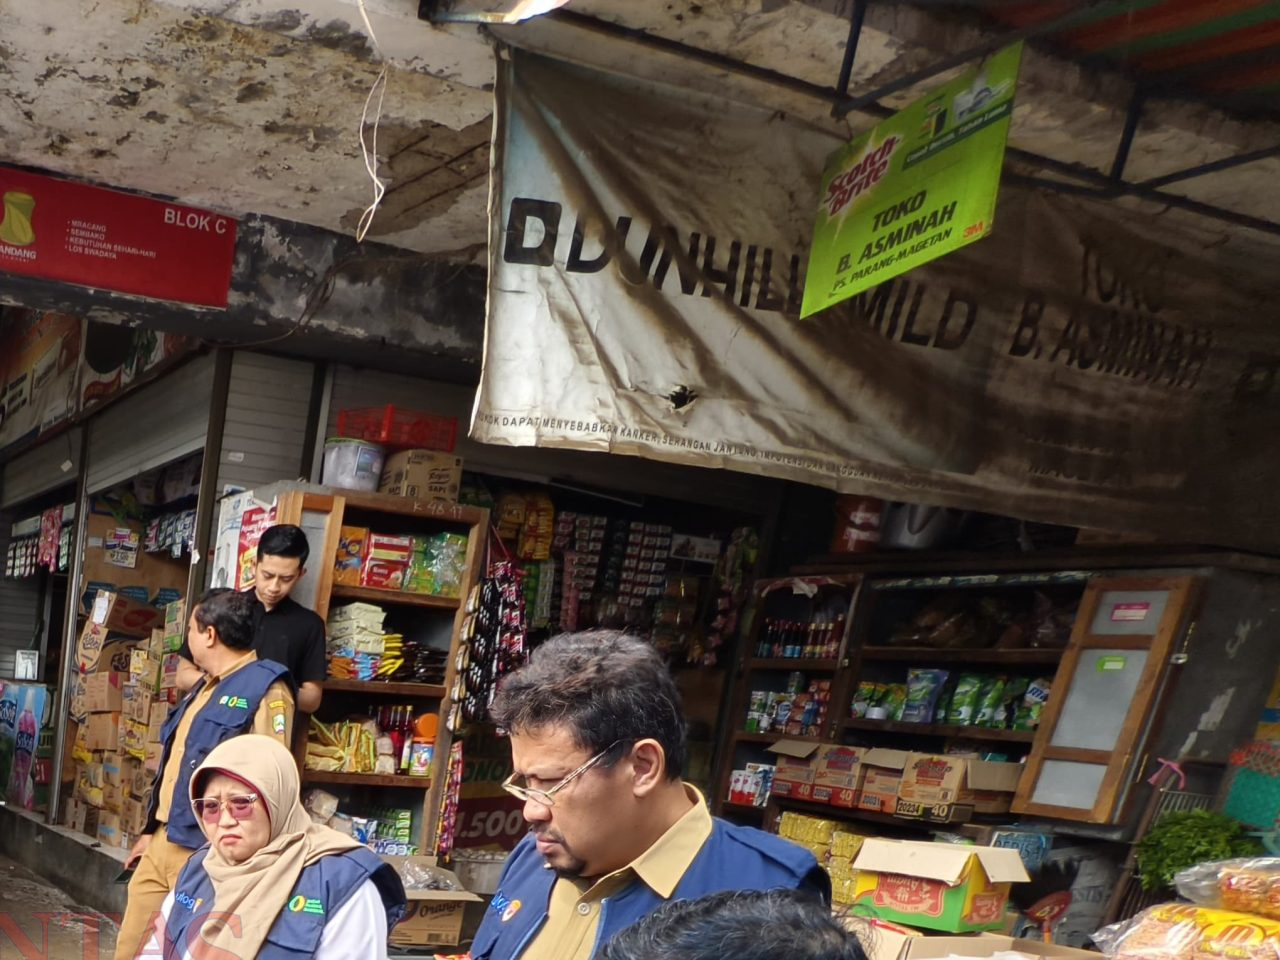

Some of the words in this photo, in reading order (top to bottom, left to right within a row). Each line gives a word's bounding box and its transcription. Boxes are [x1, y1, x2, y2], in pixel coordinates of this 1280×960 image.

[164, 208, 211, 232] BLOK
[214, 217, 227, 235] C
[872, 189, 927, 232] TOKO
[70, 228, 105, 240] SEMBAKO
[836, 253, 852, 275] B.
[858, 201, 958, 265] ASMINAH
[963, 221, 983, 239] 3M
[68, 245, 83, 255] LOS
[84, 248, 117, 260] SWADAYA
[70, 237, 112, 251] KEBUTUHAN
[833, 278, 847, 291] PS.
[850, 228, 952, 283] PARANG-MAGETAN
[566, 210, 810, 315] DUNHILL
[848, 274, 977, 350] MILD
[502, 416, 540, 427] DAPAT
[542, 418, 617, 434] MENYEBABKAN
[662, 435, 711, 451] SERANGAN
[840, 789, 852, 802] 40
[931, 803, 947, 817] 40
